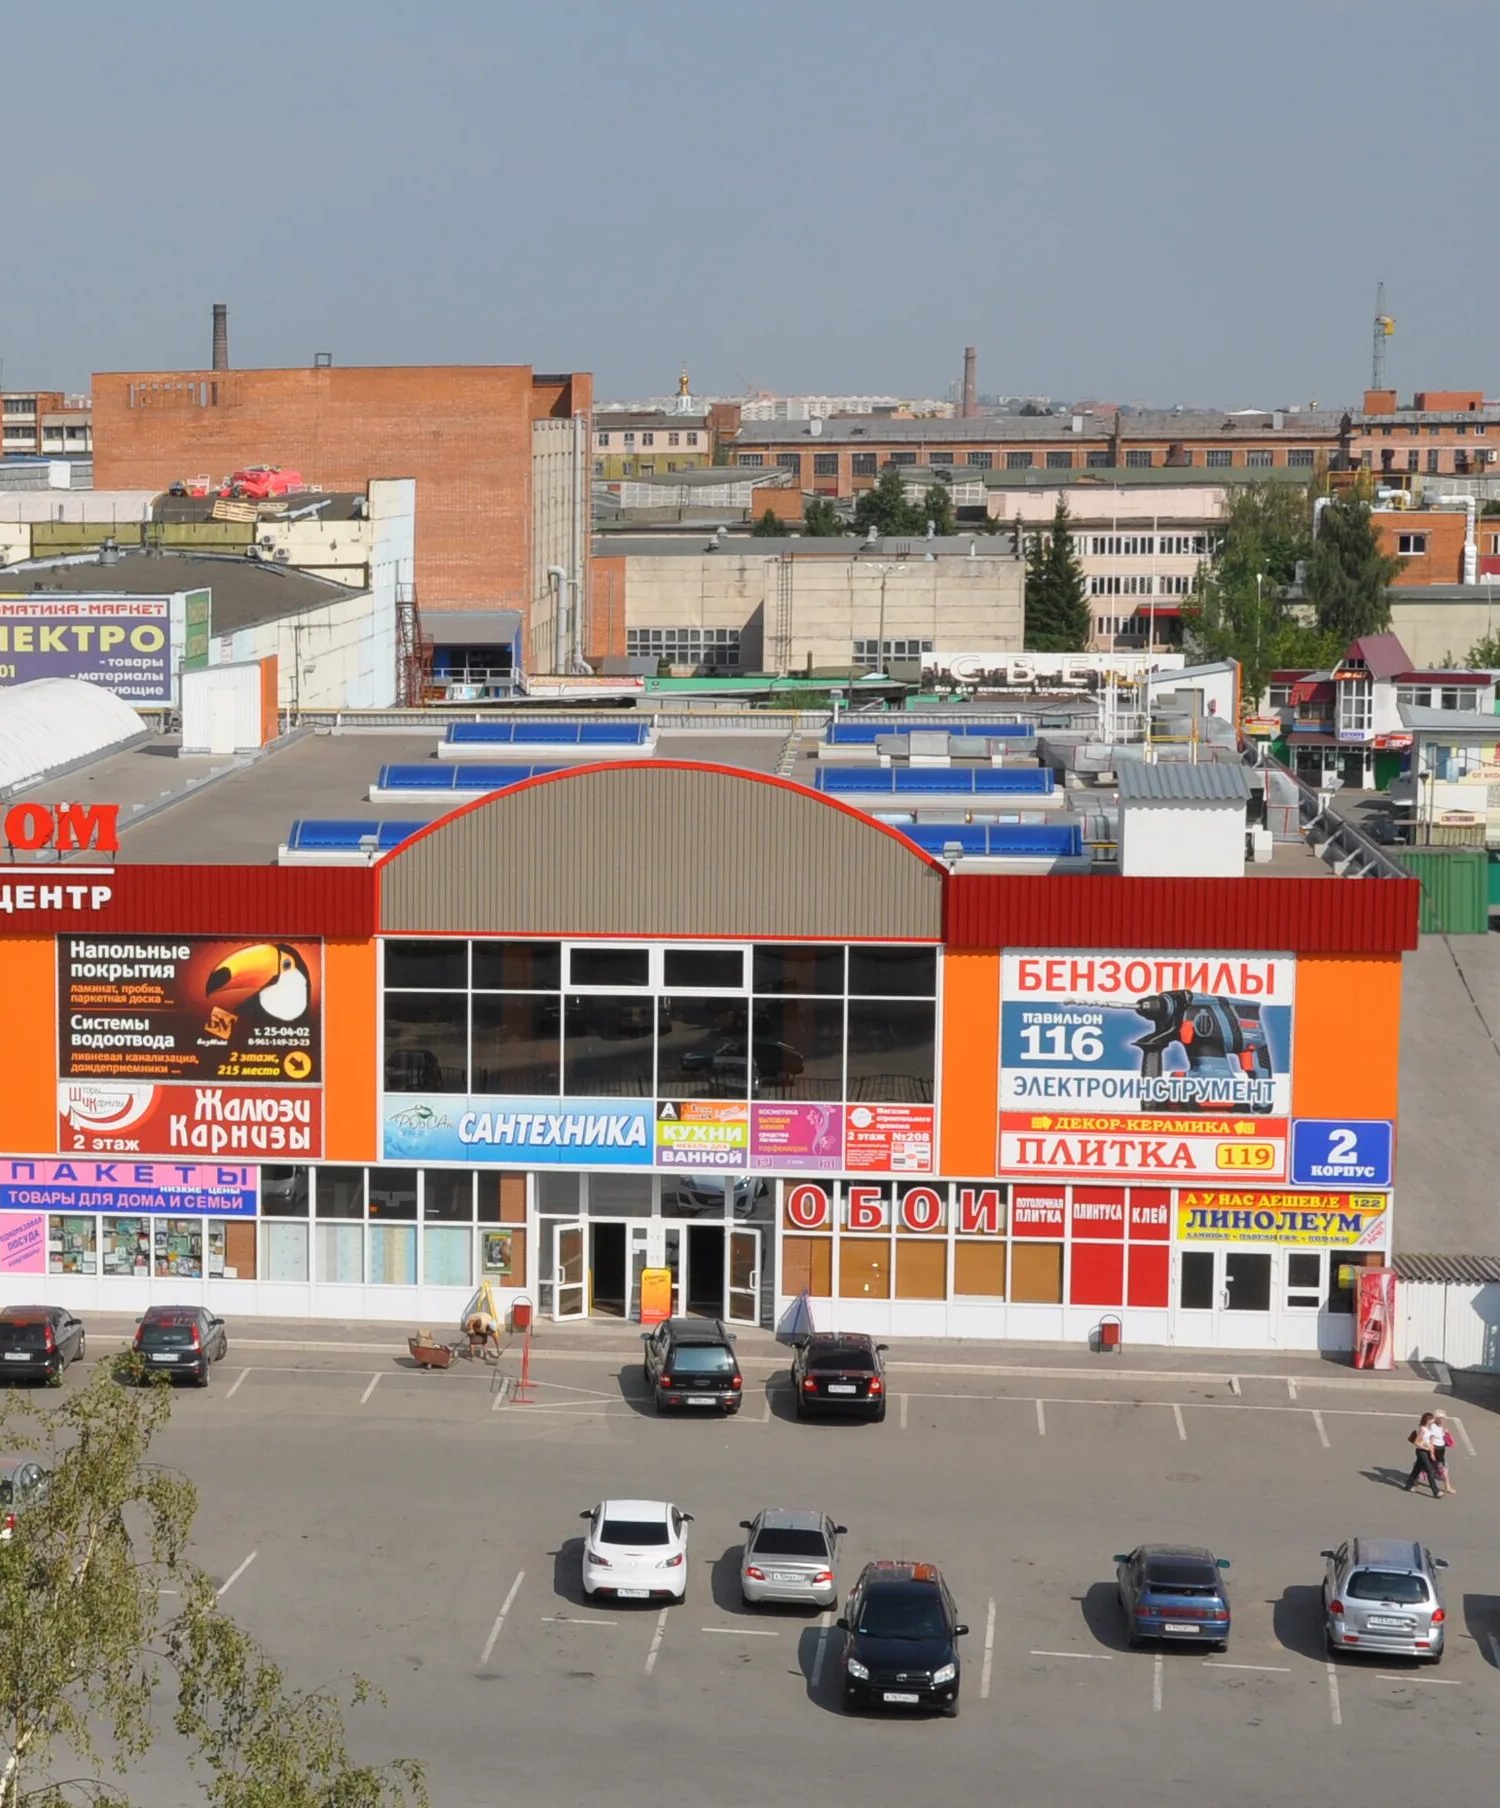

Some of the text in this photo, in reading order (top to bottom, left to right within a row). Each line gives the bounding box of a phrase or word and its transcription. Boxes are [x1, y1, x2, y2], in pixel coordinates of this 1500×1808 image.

[71, 941, 190, 959] Напольные
[70, 962, 175, 981] покрытия
[1018, 959, 1275, 994] БЕНЗОПИЛЫ
[70, 1014, 149, 1031] Системы
[1023, 1013, 1103, 1025] павильон
[264, 1027, 310, 1037] 25-04-02
[71, 1034, 175, 1049] водоотвода
[1020, 1026, 1104, 1061] 116
[71, 1052, 122, 1062] ливневая
[230, 1052, 279, 1064] 2 этаж,
[217, 1066, 280, 1075] 215 место
[1013, 1076, 1276, 1104] ЭЛЕКТРОИНСТРУМЕНТ
[194, 1089, 310, 1123] Жалюзи
[170, 1116, 310, 1153] Карнизы
[458, 1112, 647, 1146] САНТЕХНИКА
[664, 1126, 741, 1141] КУХНИ
[1055, 1117, 1231, 1134] ДЕКОР-КЕРАМИКА
[73, 1134, 140, 1151] 2 этаж
[847, 1132, 886, 1141] 2 этаж
[892, 1132, 929, 1141] №208
[1016, 1138, 1196, 1169] ПЛИТКА
[1328, 1129, 1358, 1163] 2
[662, 1151, 742, 1163] ВАННОЙ
[1223, 1147, 1270, 1166] 119
[11, 1162, 247, 1186] ПАКЕТЫ
[1311, 1165, 1375, 1178] КОРПУС
[9, 1191, 243, 1209] ТОВАРЫ ДЛЯ ДОМА И СЕМЬИ
[788, 1184, 999, 1233] ОБОИ
[1016, 1198, 1063, 1209] ПОТОЛОЧНАЯ
[1186, 1194, 1198, 1204] А
[1203, 1194, 1214, 1205] У
[1219, 1194, 1253, 1206] НАС
[1015, 1209, 1062, 1223] ПЛИТКА
[1074, 1203, 1122, 1221] ПЛИНТУСА
[1132, 1205, 1167, 1224] КЛЕЙ
[1187, 1209, 1363, 1231] ЛИНОЛЕУМ
[8, 1229, 40, 1251] ПОСУДА
